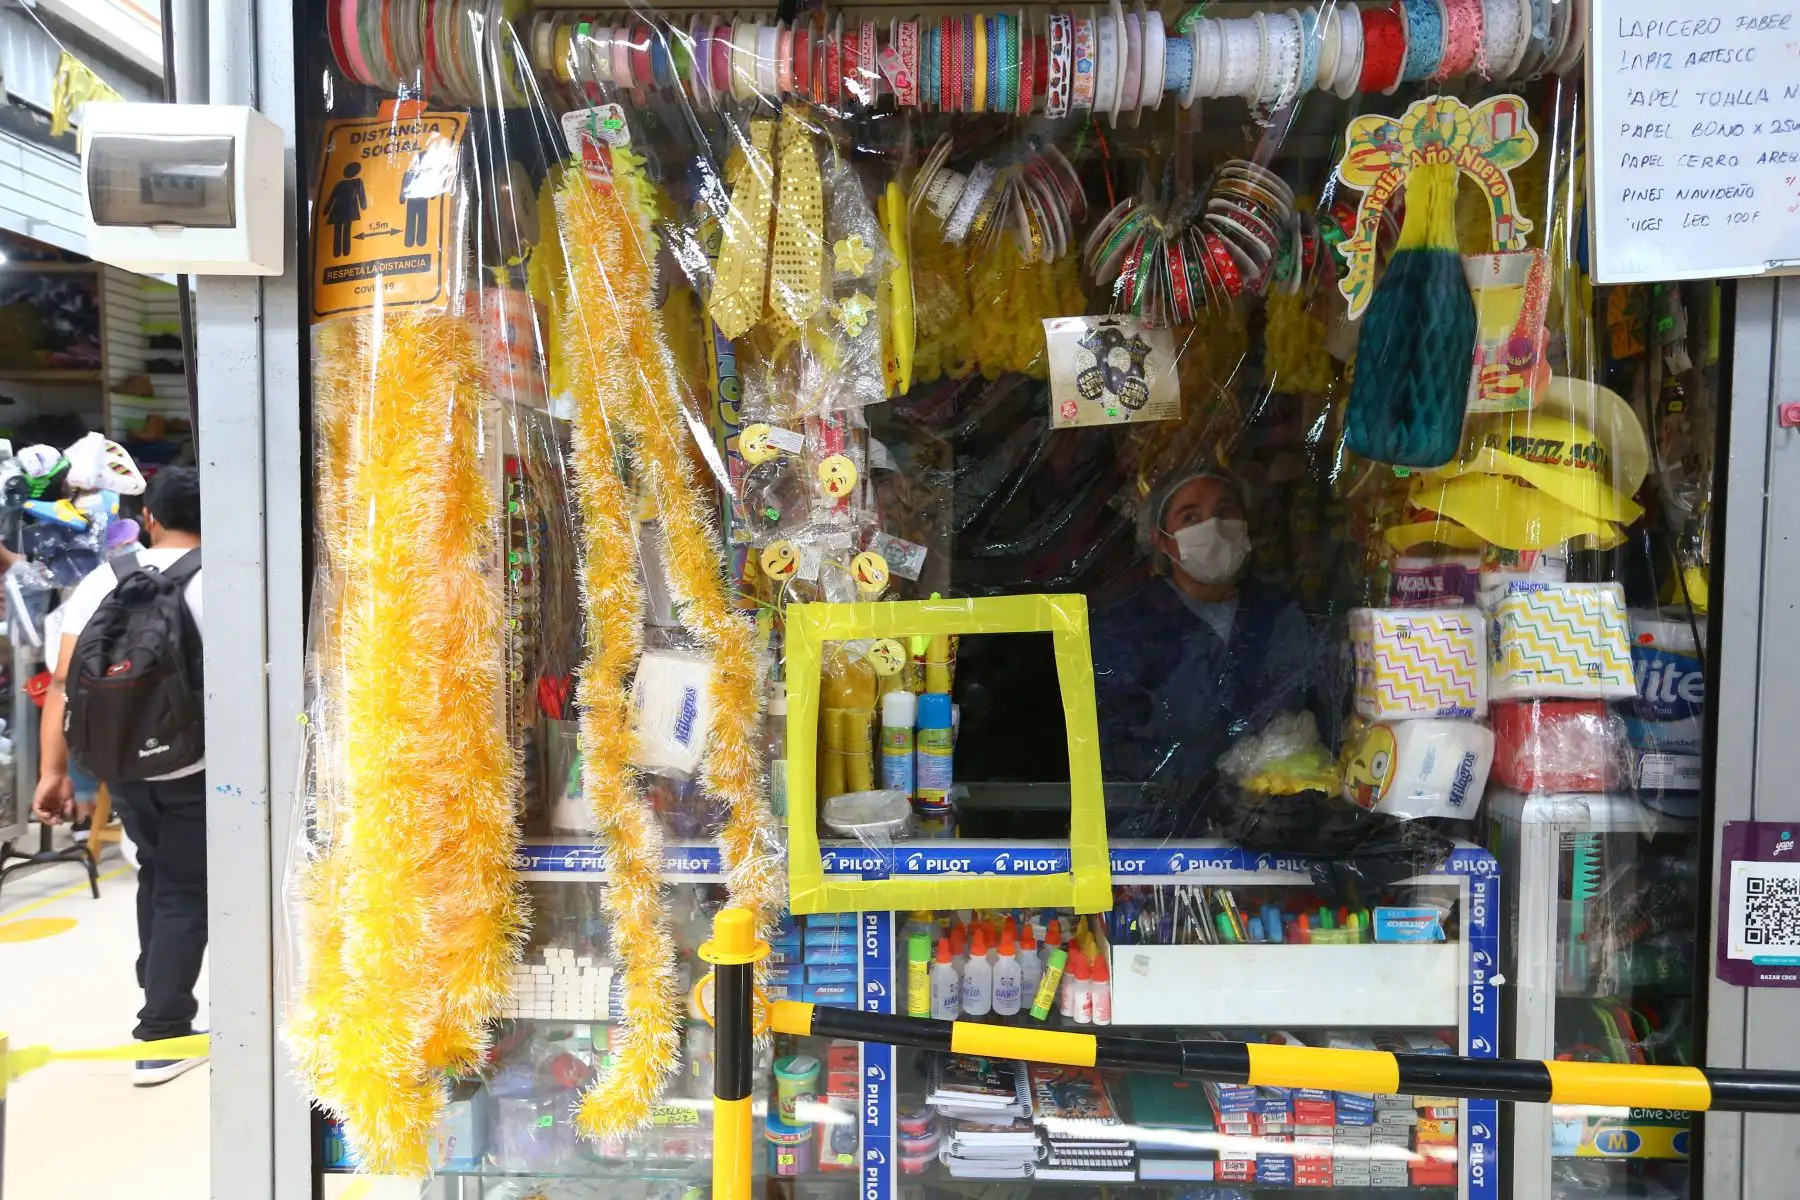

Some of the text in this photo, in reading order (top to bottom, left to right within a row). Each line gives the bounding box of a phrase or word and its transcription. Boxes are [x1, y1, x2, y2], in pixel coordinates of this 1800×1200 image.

[1619, 14, 1792, 39] LAPICERO FABER
[1627, 88, 1679, 108] APEL
[350, 122, 441, 145] DISTANCIA
[1620, 121, 1674, 139] PAPEL
[360, 139, 423, 160] SOCIAL
[1621, 152, 1666, 169] PAPEL
[1677, 154, 1740, 169] CERRO
[1364, 146, 1509, 212] Feliz Año Nuevo
[1622, 187, 1665, 202] PINES
[368, 220, 389, 231] 1,5m
[326, 258, 427, 280] RESPETA LA DISTANCIA
[354, 281, 395, 295] COVI-19
[1634, 659, 1705, 703] lite
[673, 685, 699, 747] Milagros
[667, 858, 710, 870] PILOT
[839, 859, 1058, 872] PILOT PILOT PILOT
[1112, 859, 1145, 872] ILOT
[1188, 859, 1233, 871] PILOT
[1453, 859, 1498, 873] PILOT
[1473, 882, 1485, 928] PILOT
[866, 914, 878, 958] PILOT
[1472, 969, 1485, 1015] PILOT
[867, 1083, 879, 1127] PILOT
[1608, 1133, 1628, 1151] M
[1472, 1142, 1484, 1188] PILOT
[866, 1167, 878, 1200] PILO
